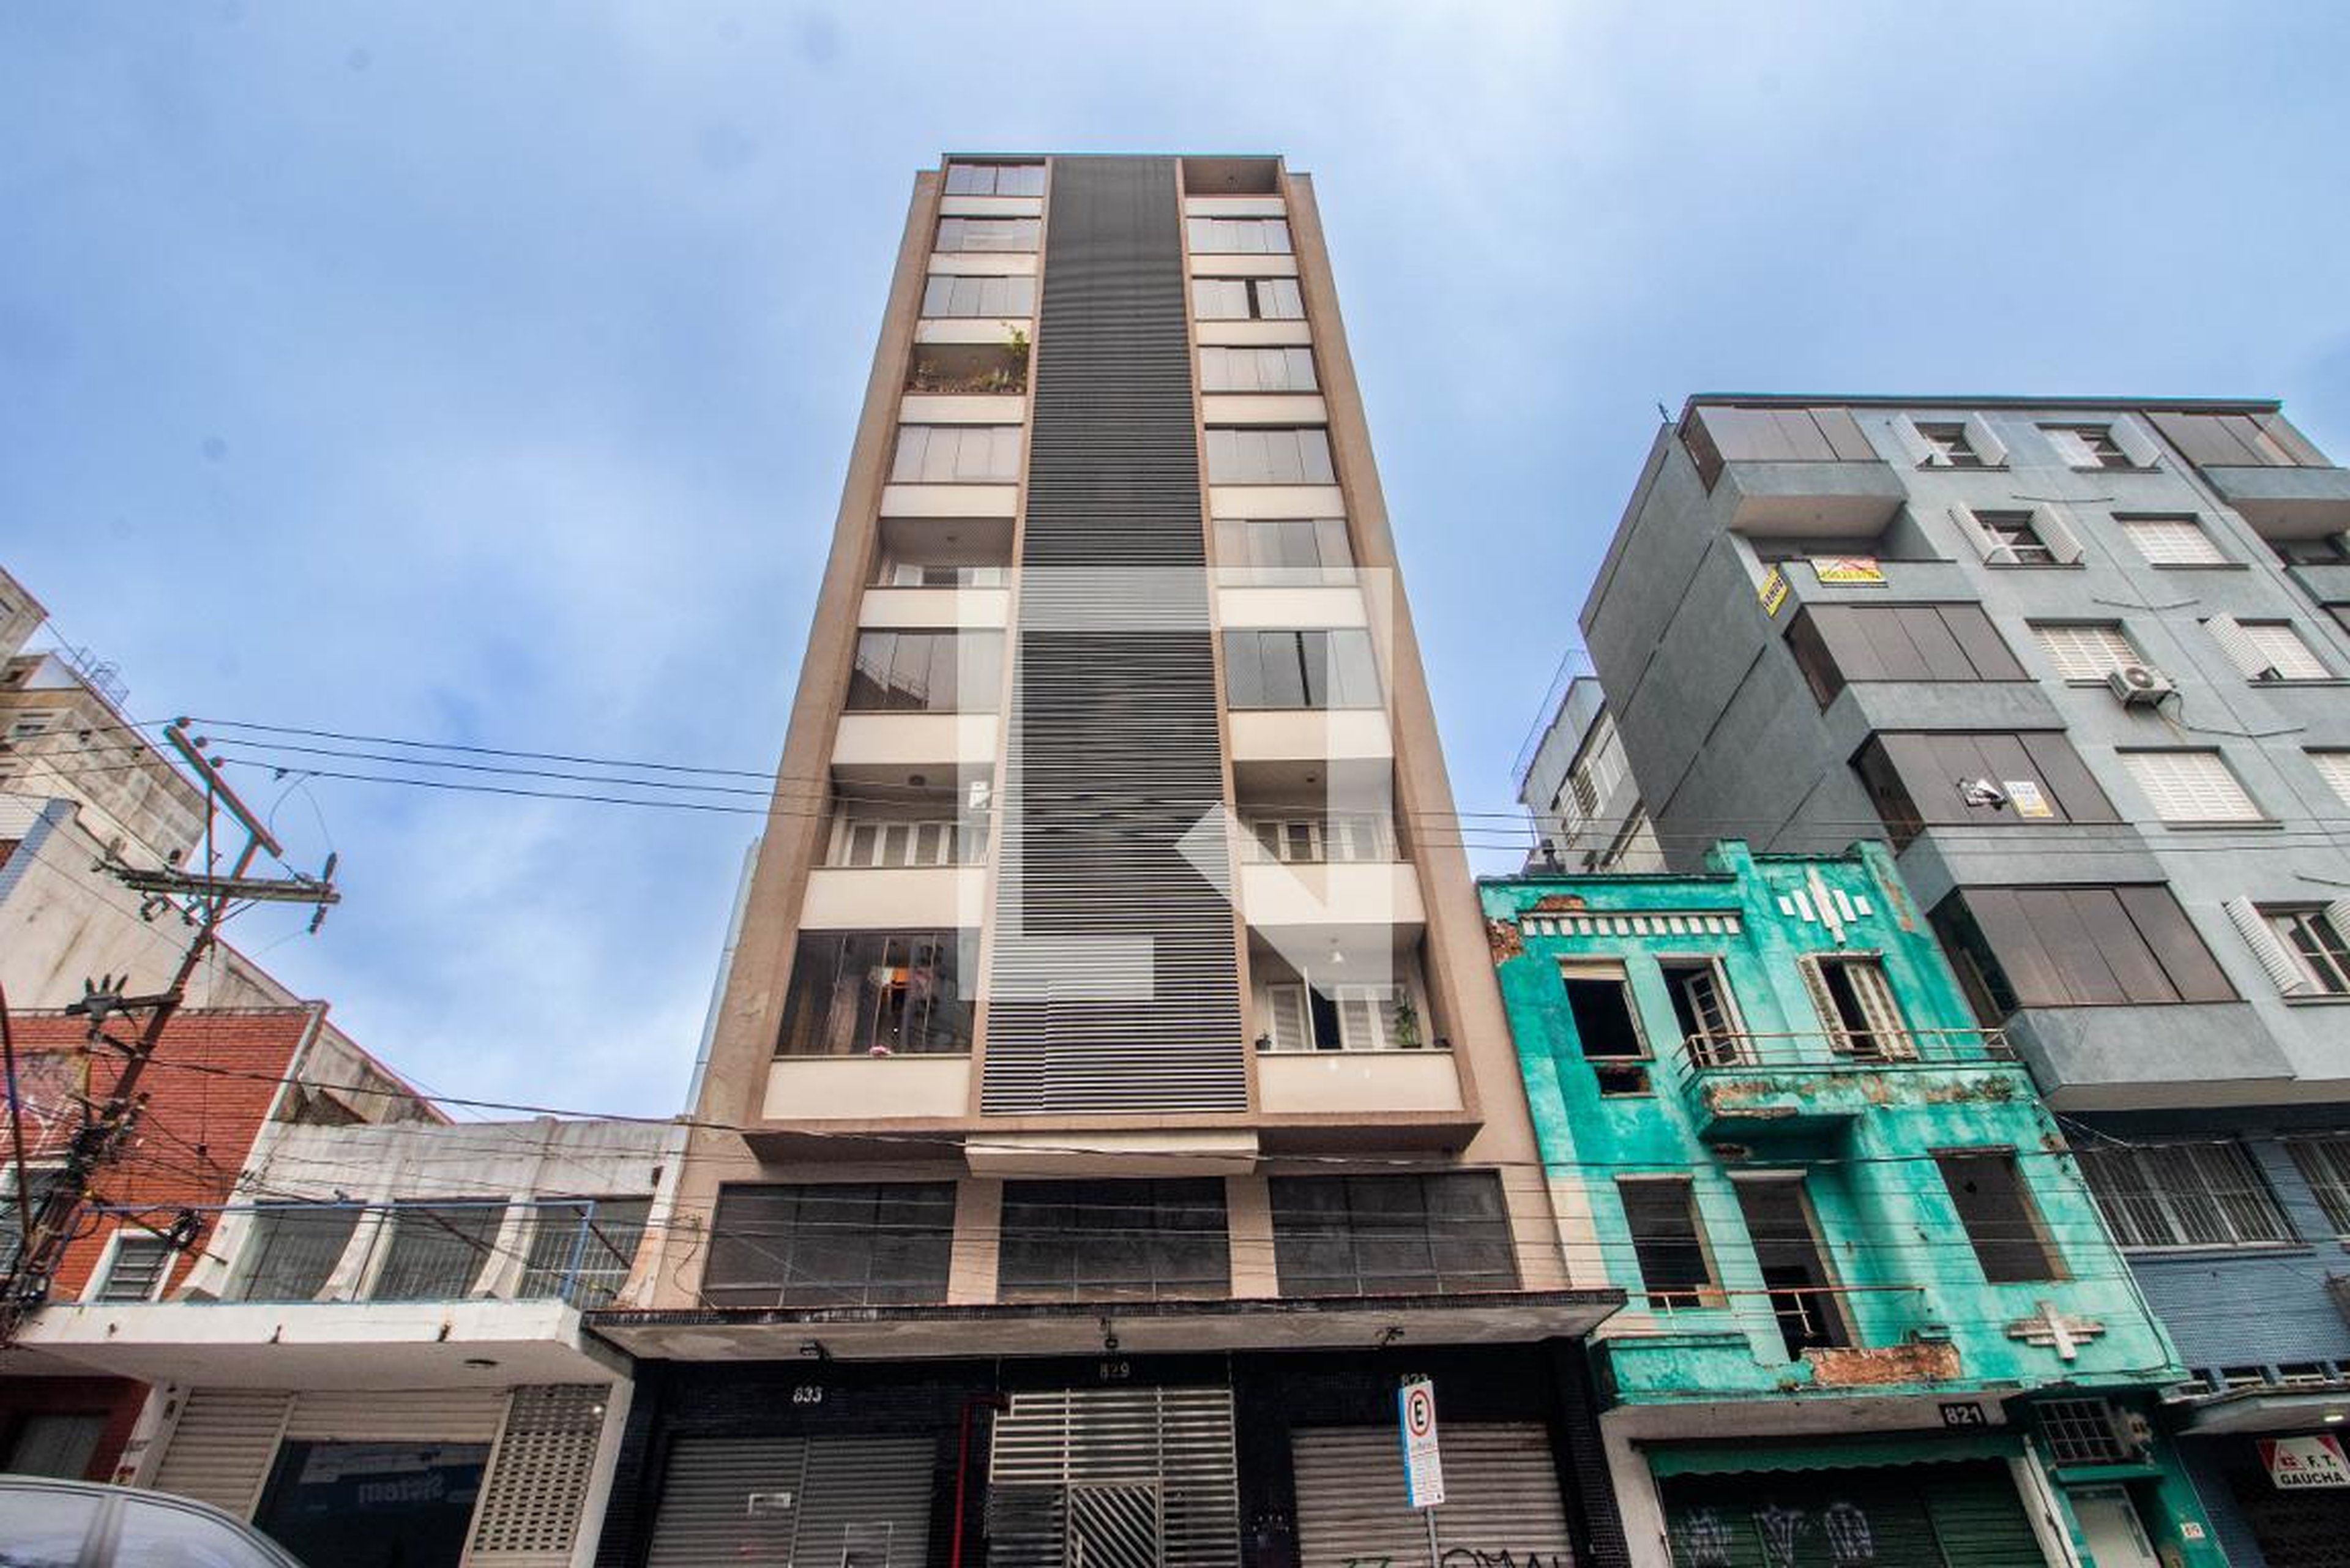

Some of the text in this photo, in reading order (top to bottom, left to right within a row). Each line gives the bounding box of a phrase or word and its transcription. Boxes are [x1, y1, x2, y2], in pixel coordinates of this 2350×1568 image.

[1415, 1400, 1424, 1427] E
[1945, 1406, 1982, 1424] 821
[2280, 1472, 2346, 1484] GAUCHA
